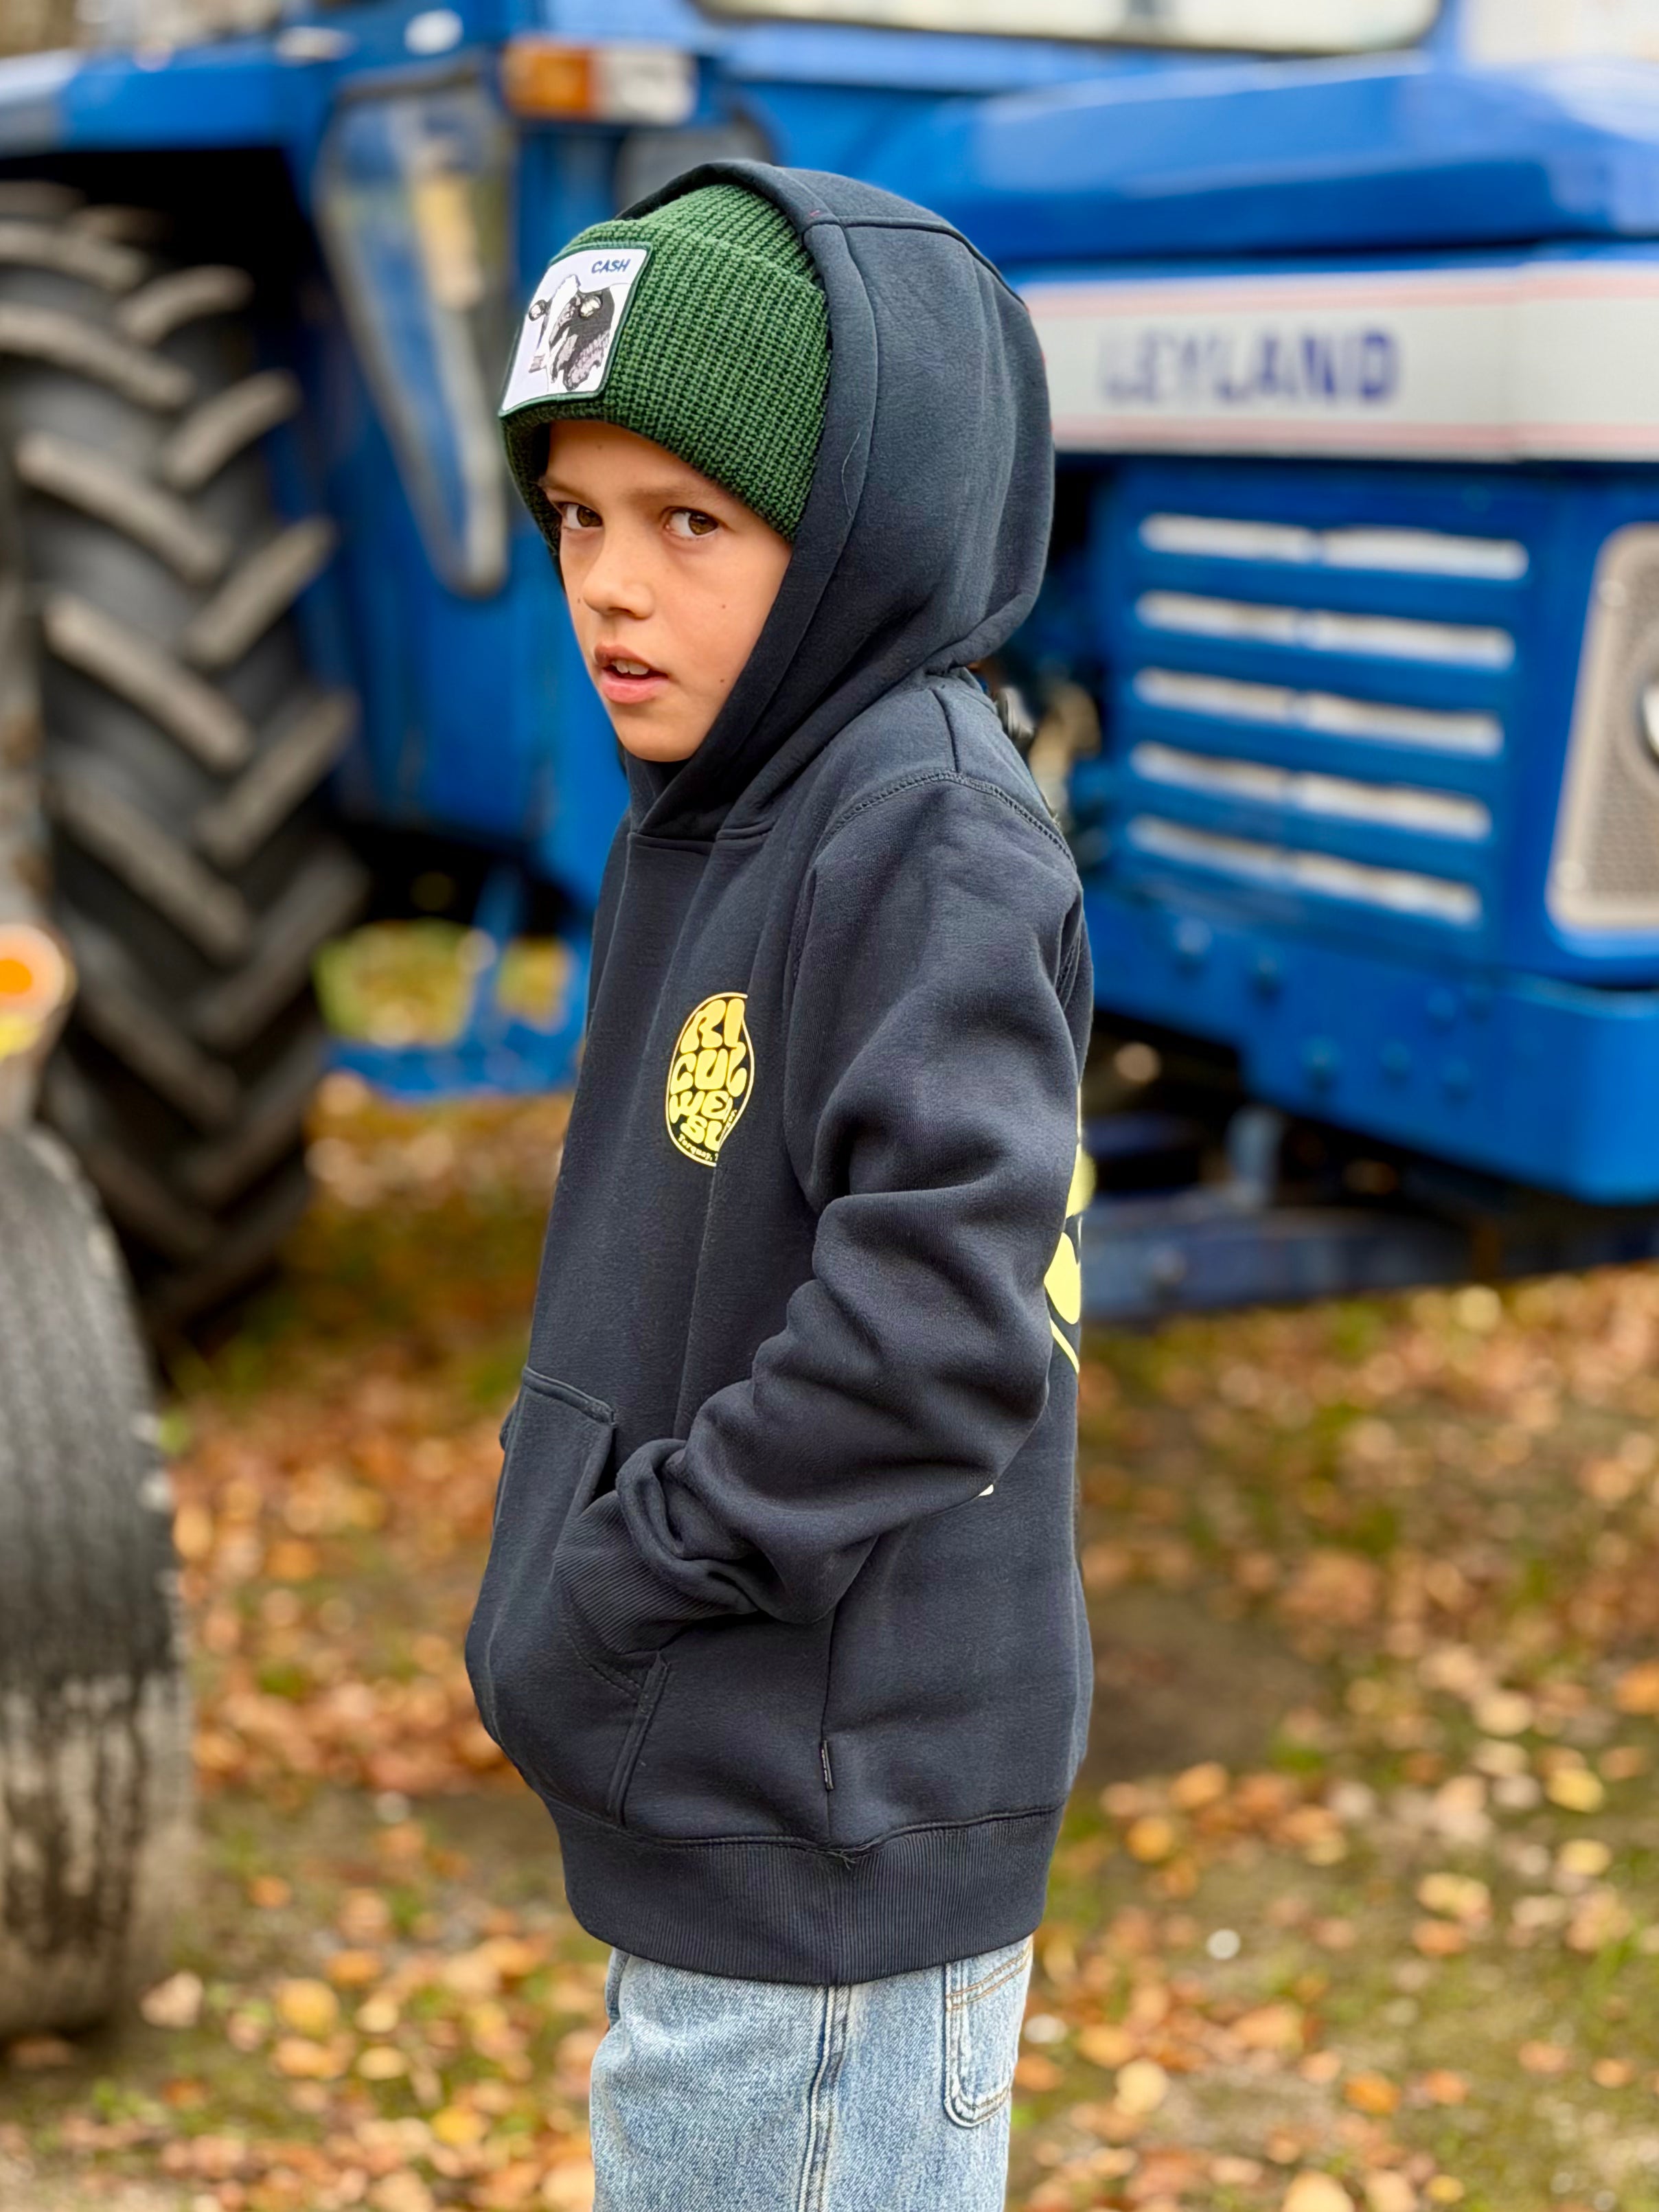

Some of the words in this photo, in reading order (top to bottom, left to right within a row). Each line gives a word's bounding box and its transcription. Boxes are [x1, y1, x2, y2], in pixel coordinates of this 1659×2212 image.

[591, 259, 631, 274] CASH
[1099, 331, 1401, 405] LEYLAND
[680, 998, 744, 1053] RI
